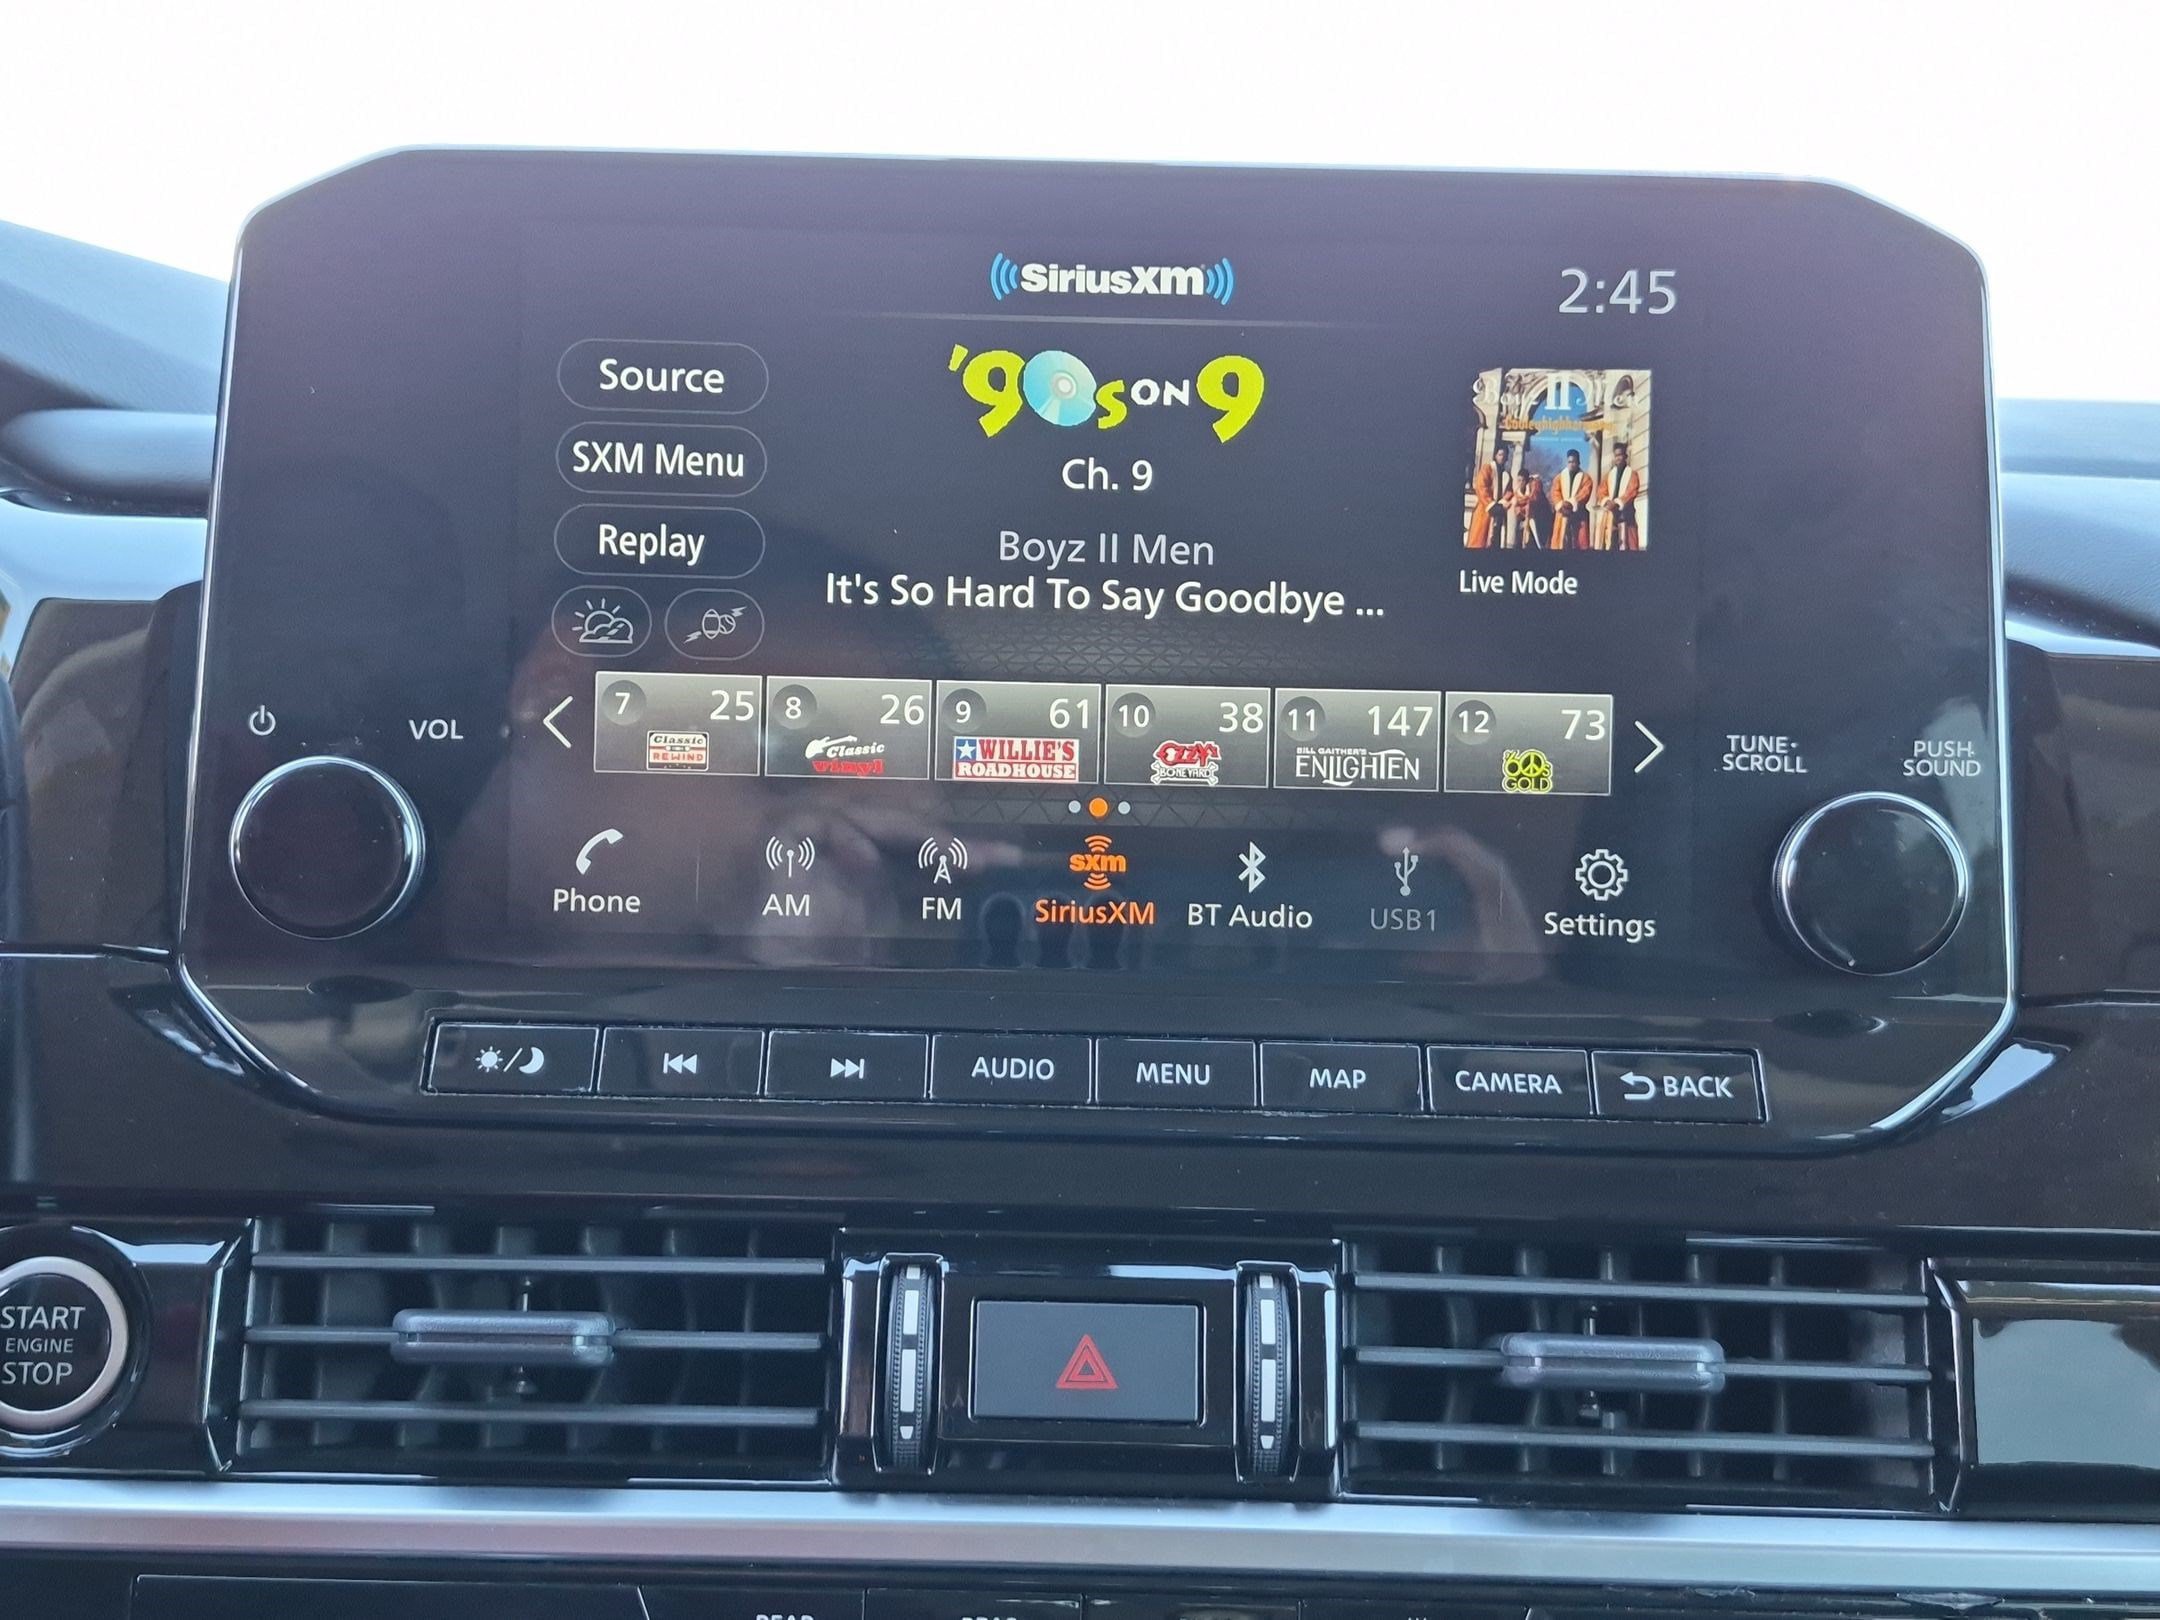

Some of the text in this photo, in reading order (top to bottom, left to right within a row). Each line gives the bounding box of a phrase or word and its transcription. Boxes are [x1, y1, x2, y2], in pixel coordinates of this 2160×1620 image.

[1558, 268, 1677, 315] 2:45
[599, 357, 725, 394] Source
[1196, 355, 1265, 443] 9
[572, 440, 744, 477] SXM Menu
[1061, 457, 1153, 491] Ch. 9
[598, 523, 705, 567] Replay
[999, 530, 1215, 570] Boyz II Men
[1459, 570, 1578, 595] Live Mode
[825, 572, 879, 606] It's
[890, 574, 934, 607] So
[945, 576, 1035, 609] Hard
[1046, 578, 1091, 610] To
[1101, 579, 1165, 620] Say
[1175, 581, 1346, 624] Goodbye
[615, 692, 631, 715] 7
[709, 689, 755, 721] 25
[784, 696, 803, 720] 8
[879, 694, 925, 725] 26
[954, 700, 972, 723] 9
[1049, 698, 1090, 730] 61
[1118, 704, 1150, 728] 10
[1218, 701, 1264, 733] 38
[1287, 708, 1317, 731] 11
[1367, 705, 1433, 737] 147
[1457, 710, 1490, 734] 12
[1561, 709, 1606, 741] 73
[408, 719, 464, 740] VOL
[653, 735, 704, 745] Classic
[653, 752, 704, 762] REWIND
[826, 742, 886, 759] Classic
[977, 738, 1076, 762] WILLIE'S
[1296, 747, 1368, 756] BILL GAITHER'S
[1913, 740, 1973, 758] PUSH
[956, 761, 1077, 780] ROADHOUSE
[1295, 748, 1420, 787] ENLIGHTEN
[1722, 754, 1808, 773] SCROLL
[1902, 759, 1982, 777] SOUND
[1504, 776, 1552, 792] GOLD
[1069, 853, 1126, 872] sxm
[552, 888, 642, 914] Phone
[762, 894, 811, 917] AM
[921, 897, 962, 920] FM
[1034, 900, 1156, 925] SiriusXM
[1187, 904, 1313, 929] BT Audio
[1370, 908, 1437, 932] USB1
[1543, 911, 1657, 944] Settings
[971, 1057, 1055, 1081] AUDIO
[1136, 1062, 1212, 1086] MENU
[1309, 1068, 1367, 1089] MAP
[1455, 1070, 1563, 1095] CAMERA
[1663, 1075, 1735, 1099] BACK
[0, 1305, 86, 1330] START
[5, 1337, 74, 1354] ENGINE
[1, 1361, 73, 1386] STOP
